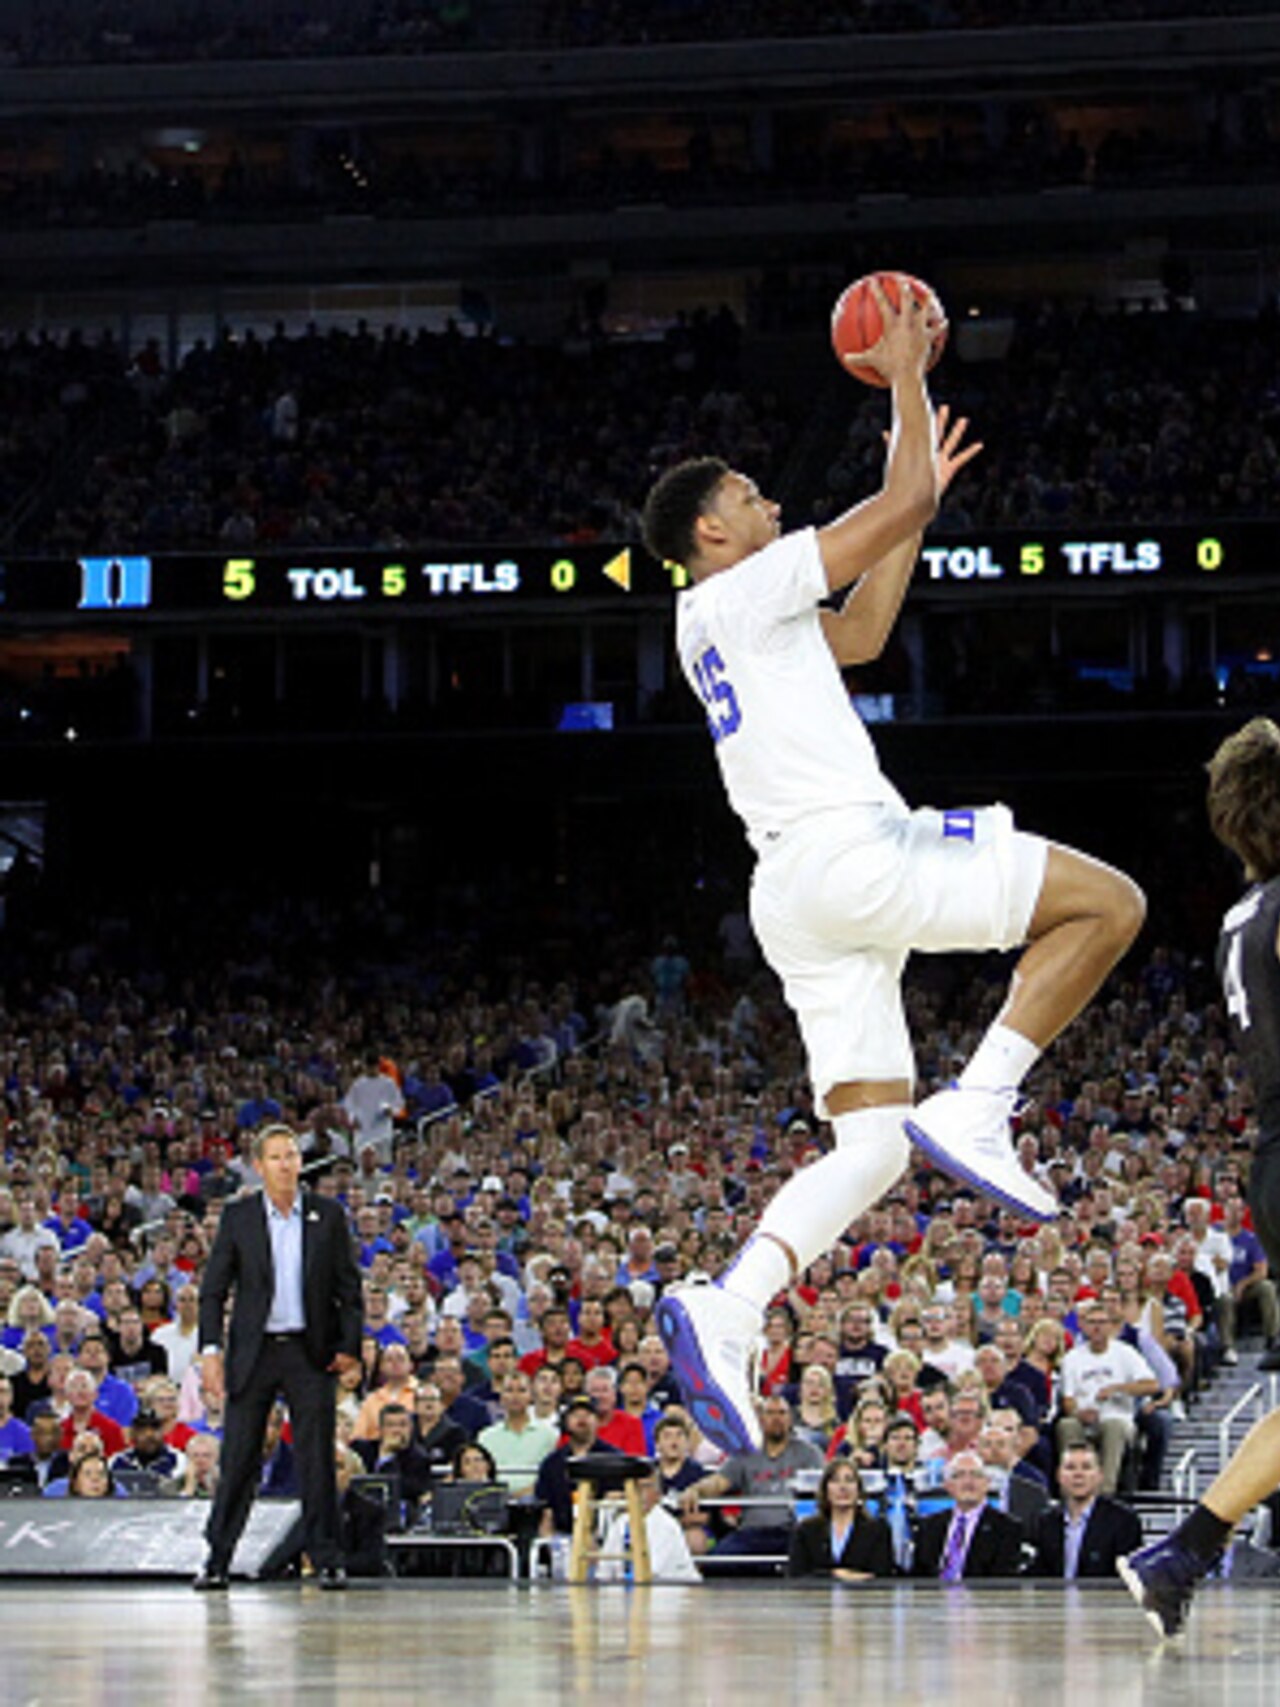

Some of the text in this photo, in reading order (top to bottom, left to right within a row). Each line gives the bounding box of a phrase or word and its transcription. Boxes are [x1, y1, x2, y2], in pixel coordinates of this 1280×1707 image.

[922, 538, 1222, 579] TOL 5 TFLS 0
[223, 559, 576, 600] 5 TOL 5 TFLS 0
